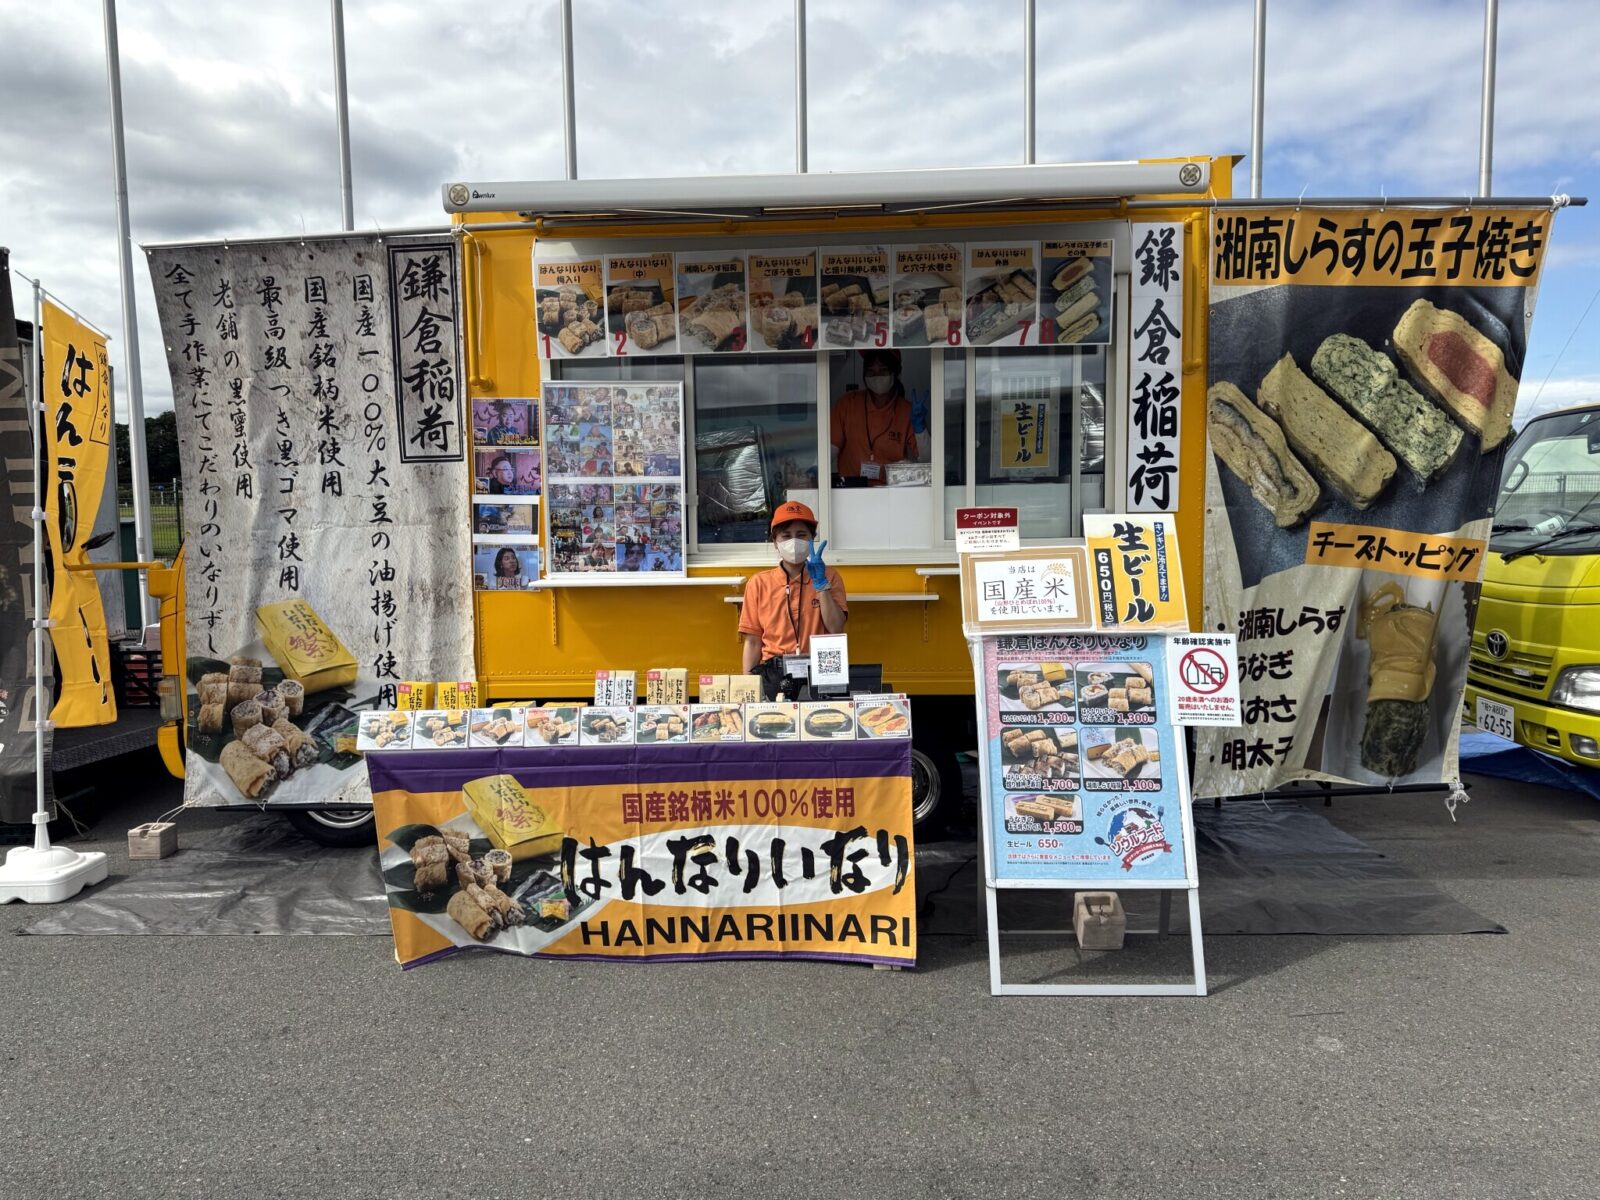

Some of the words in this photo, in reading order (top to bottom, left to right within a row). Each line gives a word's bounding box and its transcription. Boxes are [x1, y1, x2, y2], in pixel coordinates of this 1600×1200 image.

[828, 256, 881, 265] はんなりいなり
[898, 253, 957, 263] はんなりいなり
[1214, 215, 1544, 281] 湘南しらすの玉子焼き
[539, 264, 597, 275] はんなりいなり
[609, 258, 668, 269] はんなりいなり
[756, 258, 808, 268] はんなりいなり
[615, 330, 627, 355] 2
[732, 327, 745, 352] 3
[801, 325, 813, 350] 4
[875, 322, 888, 347] 5
[947, 321, 961, 345] 6
[1018, 321, 1031, 345] 7
[399, 254, 454, 452] 鎌倉稲荷
[541, 336, 552, 359] 1
[1130, 228, 1180, 510] 鎌倉稲荷
[213, 279, 254, 500] 老舗の黒蜜使用
[304, 275, 346, 497] 国産銘柄米使用
[255, 275, 303, 592] 最高級つき黒ゴマ使用
[1014, 402, 1033, 462] 生ビール
[165, 263, 224, 655] 全て手作業にてこだわりのいなりずし
[1312, 531, 1480, 573] チーズトッピング
[1008, 564, 1036, 574] 当店は
[1112, 520, 1155, 623] 生ビール
[983, 577, 1070, 601] 国産米
[990, 604, 1070, 615] を使用しています。
[1237, 605, 1347, 642] 湘南しらす
[996, 635, 1148, 651] 鎌倉はんなりいなり
[1173, 637, 1231, 646] 年齢確認実施中
[1484, 713, 1512, 738] 62-55
[1220, 735, 1295, 771] 明太子
[622, 787, 856, 824] 国産銘柄米100%使用
[560, 825, 910, 906] はんなりいなり
[580, 912, 910, 947] HANNARIINARI
